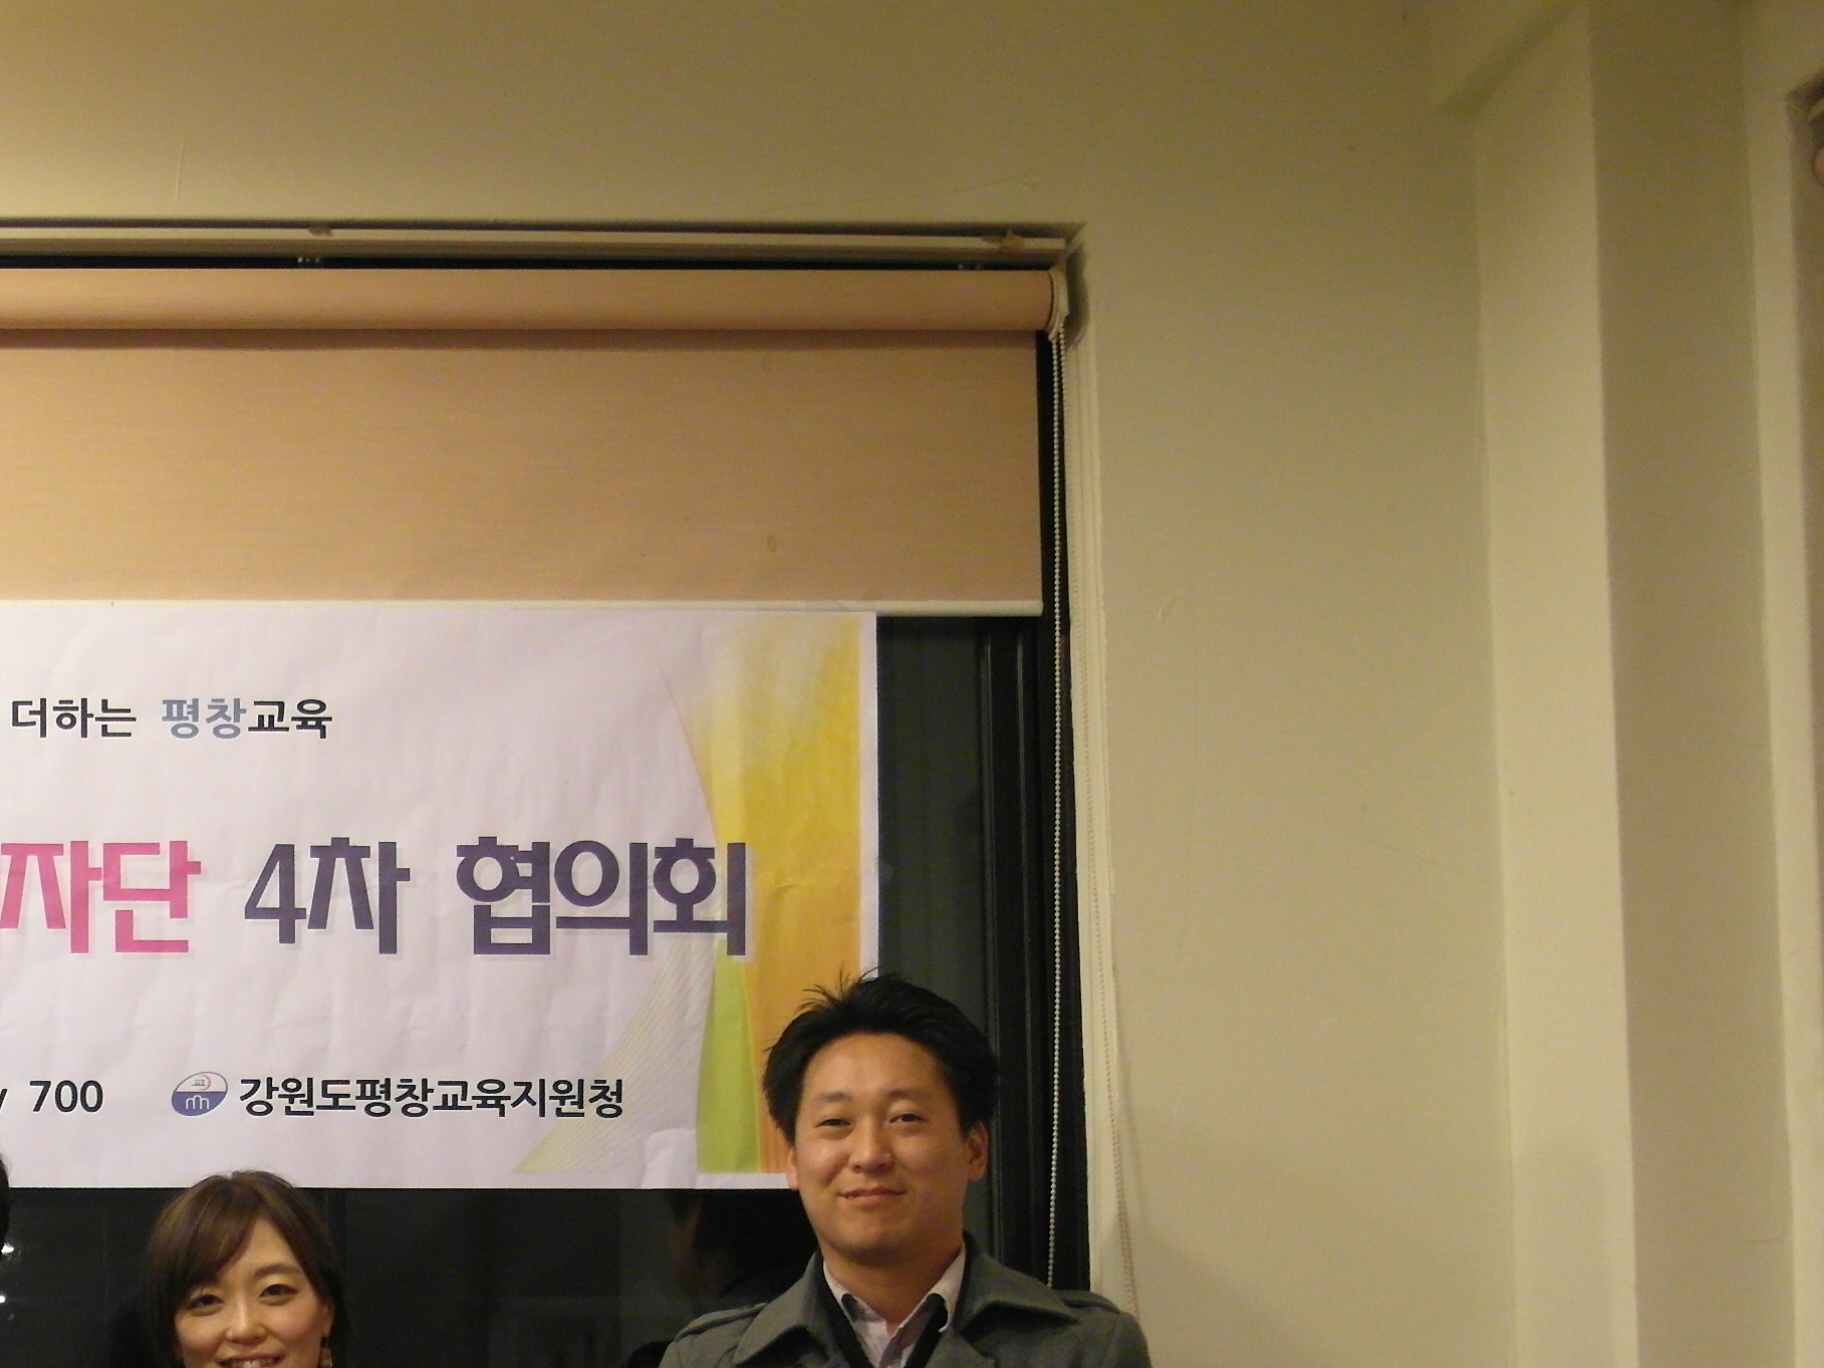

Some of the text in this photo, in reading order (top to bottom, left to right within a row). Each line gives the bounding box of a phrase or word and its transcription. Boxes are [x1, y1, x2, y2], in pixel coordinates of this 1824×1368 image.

[12, 697, 136, 740] 더하는
[162, 697, 333, 740] 평창교육
[244, 836, 411, 956] 4차
[455, 835, 750, 957] 협의회
[30, 1080, 104, 1113] 700
[239, 1076, 624, 1119] 강원도평창교육지원청
